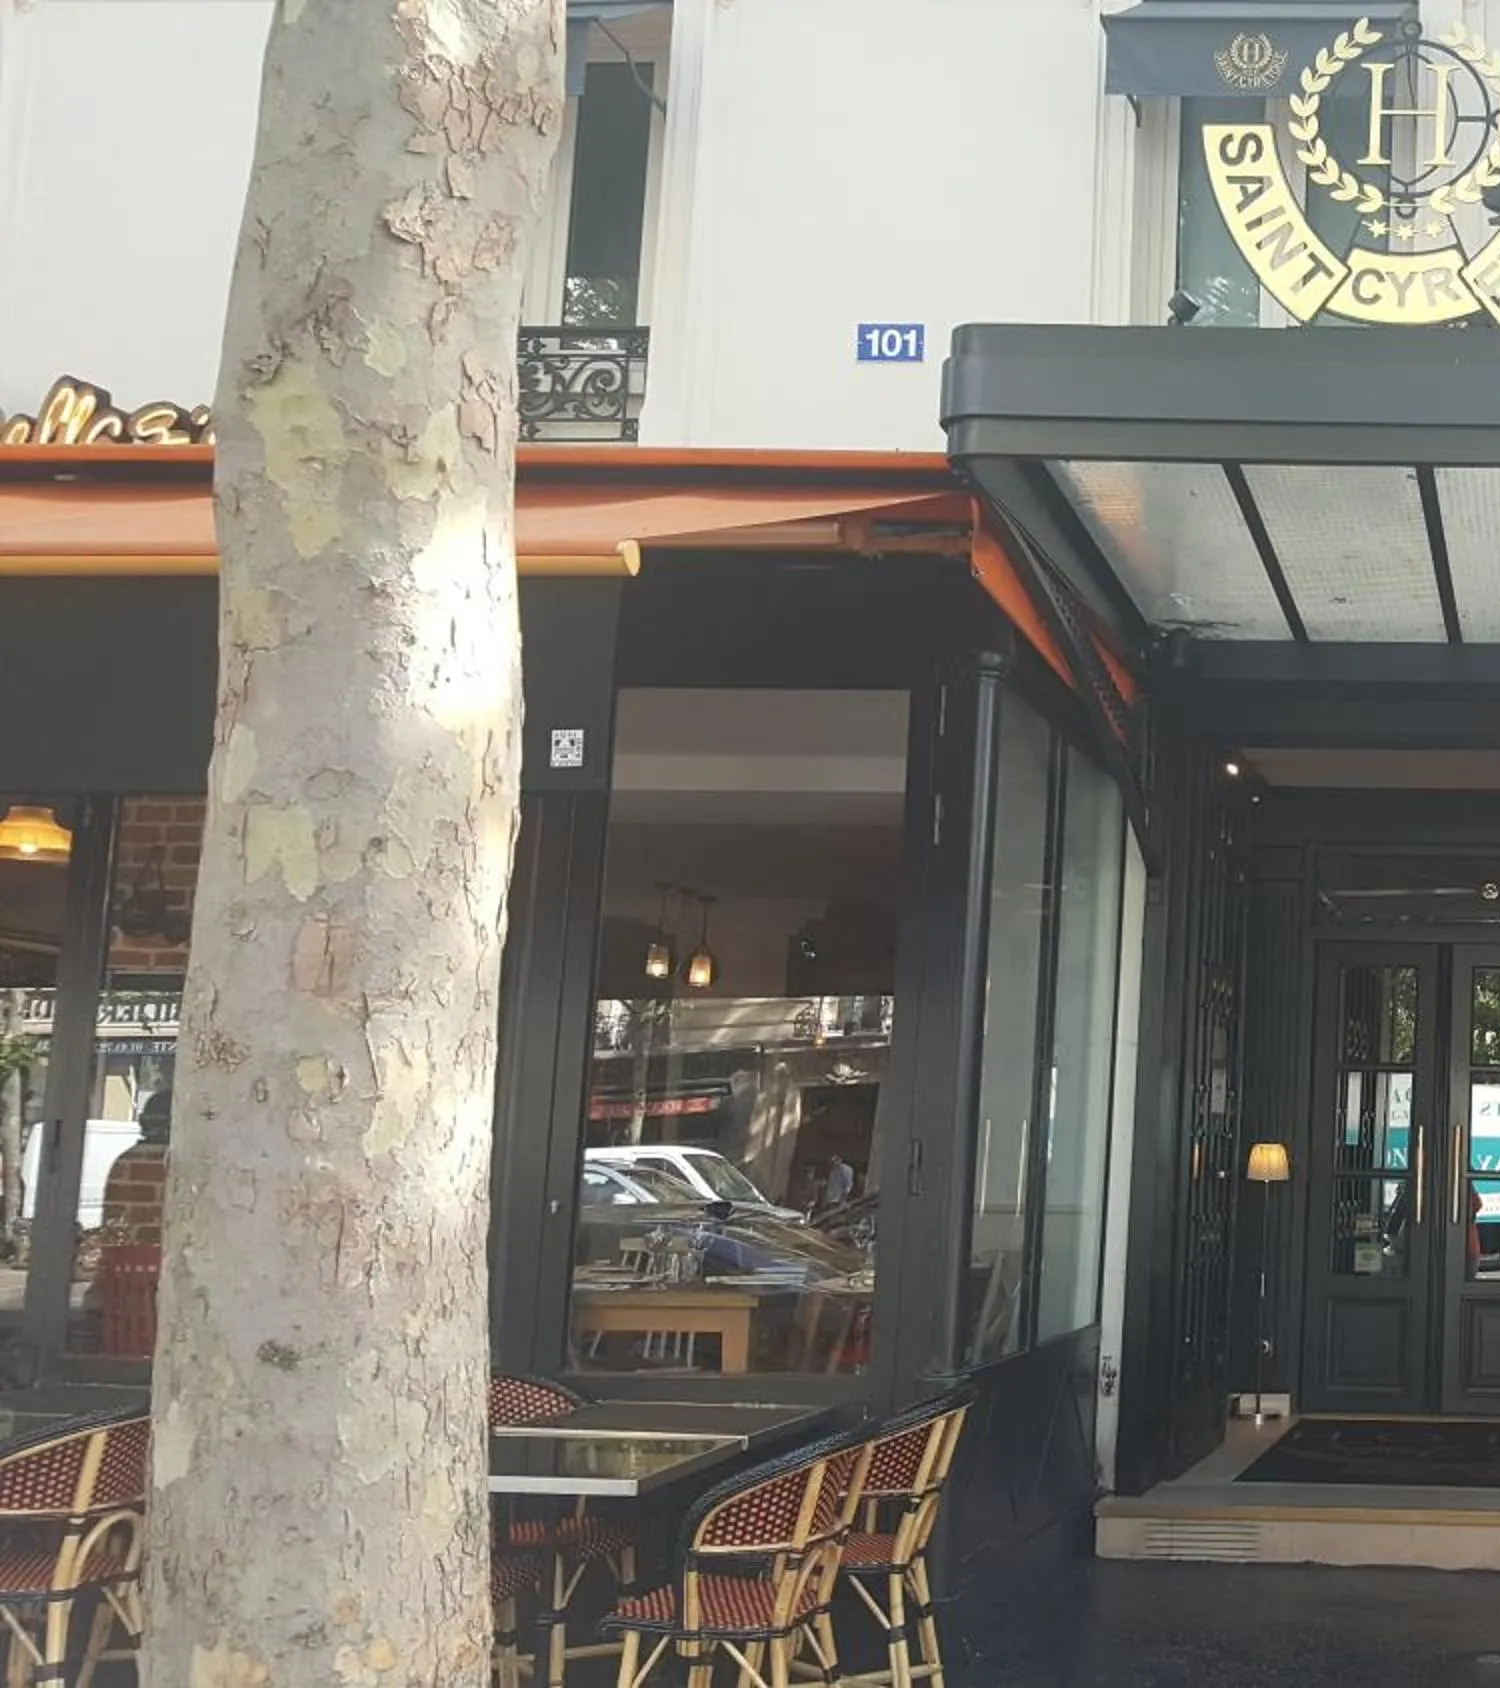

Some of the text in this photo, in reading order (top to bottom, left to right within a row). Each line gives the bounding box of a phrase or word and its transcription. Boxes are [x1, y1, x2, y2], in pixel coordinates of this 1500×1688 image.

[1356, 62, 1460, 166] H
[1218, 131, 1335, 295] SAINT
[1351, 266, 1462, 308] CYR
[865, 328, 917, 357] 101
